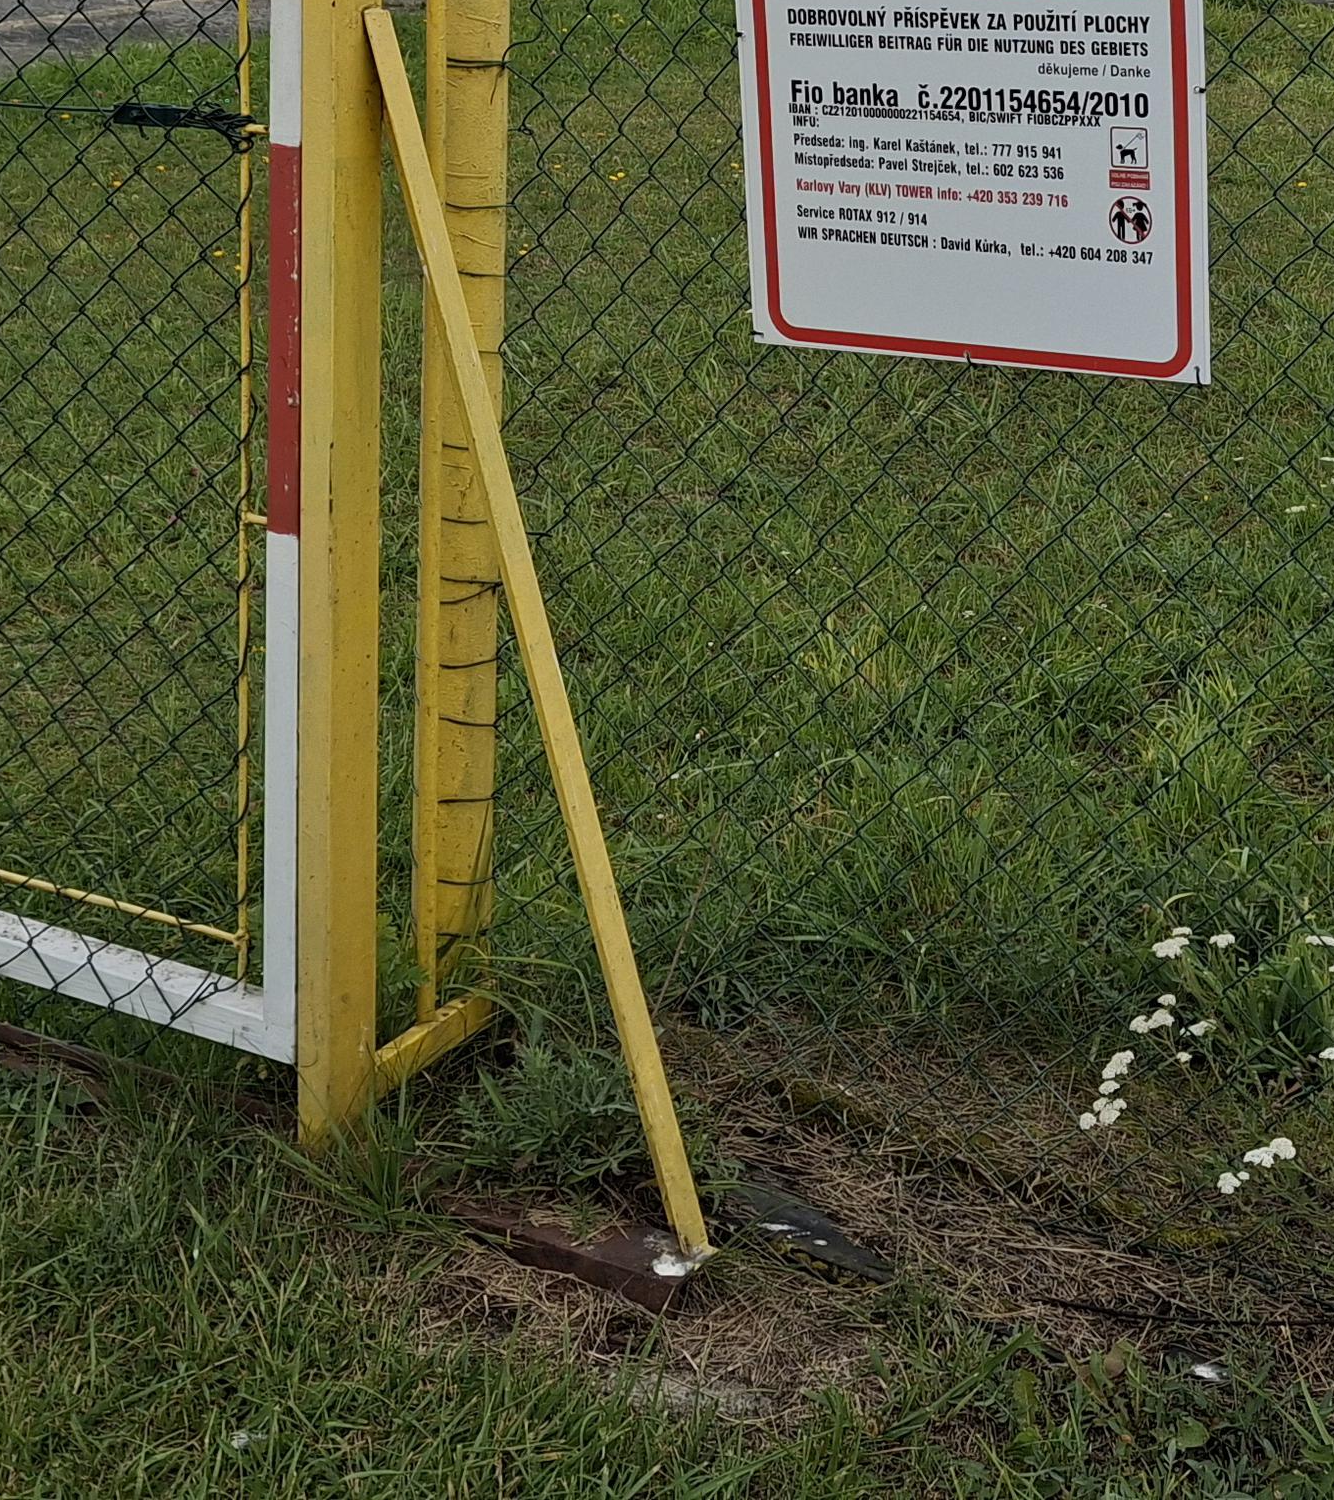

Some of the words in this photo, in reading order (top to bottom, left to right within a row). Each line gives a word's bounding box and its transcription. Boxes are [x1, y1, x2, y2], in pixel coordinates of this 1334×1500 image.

[787, 7, 886, 27] DOBROVOLNÝ
[894, 7, 980, 30] PŘÍSPĚVEK
[987, 13, 1006, 30] ZA
[1014, 10, 1077, 32] POUŽITÍ
[1084, 16, 1149, 34] PLOCHY
[790, 33, 873, 49] FREIWILLIGER
[879, 35, 932, 50] BEITRAG
[938, 34, 962, 52] FÜR
[968, 38, 988, 53] DIE
[994, 39, 1054, 54] NUTZUNG
[1060, 41, 1086, 56] DES
[1091, 41, 1148, 57] GEBIETS
[1038, 63, 1098, 78] děkujeme
[1110, 65, 1150, 78] Danke
[791, 80, 823, 106] Fio
[833, 82, 899, 107] banka
[918, 83, 1149, 118] č.2201154654/2010
[789, 103, 810, 114] IBAN
[969, 112, 1022, 124] BIC/SWIFT
[1028, 113, 1101, 127] FIOBCZPPXXX
[794, 133, 844, 148] Předseda:
[874, 137, 901, 151] Karel
[906, 139, 960, 156] Kaštánek,
[965, 143, 987, 155] tel.:
[992, 144, 1011, 157] 777
[1017, 145, 1037, 158] 915
[1042, 146, 1061, 159] 941
[795, 152, 874, 169] Místopředseda:
[879, 158, 907, 171] Pavel
[912, 159, 960, 175] Strejček,
[966, 163, 988, 175] tel.:
[994, 164, 1013, 176] 602
[1019, 165, 1038, 178] 623
[1044, 167, 1064, 179] 536
[797, 179, 834, 195] Karlovy
[838, 181, 860, 197] Vary
[865, 183, 891, 198] (KLV)
[896, 185, 932, 199] TOWER
[967, 189, 992, 203] +420
[997, 191, 1017, 204] 353
[1022, 193, 1043, 206] 239
[1048, 194, 1068, 207] 716
[797, 205, 835, 219] Service
[839, 208, 872, 222] ROTAX
[877, 211, 895, 223] 912
[908, 213, 927, 225] 914
[798, 227, 817, 239] WIR
[822, 228, 876, 244] SPRACHEN
[881, 232, 928, 248] DEUTSCH
[941, 237, 970, 251] David
[1021, 243, 1043, 256] tel.:
[1048, 246, 1076, 259] +420
[1081, 248, 1101, 261] 604
[1106, 249, 1127, 262] 208
[1132, 251, 1152, 265] 347
